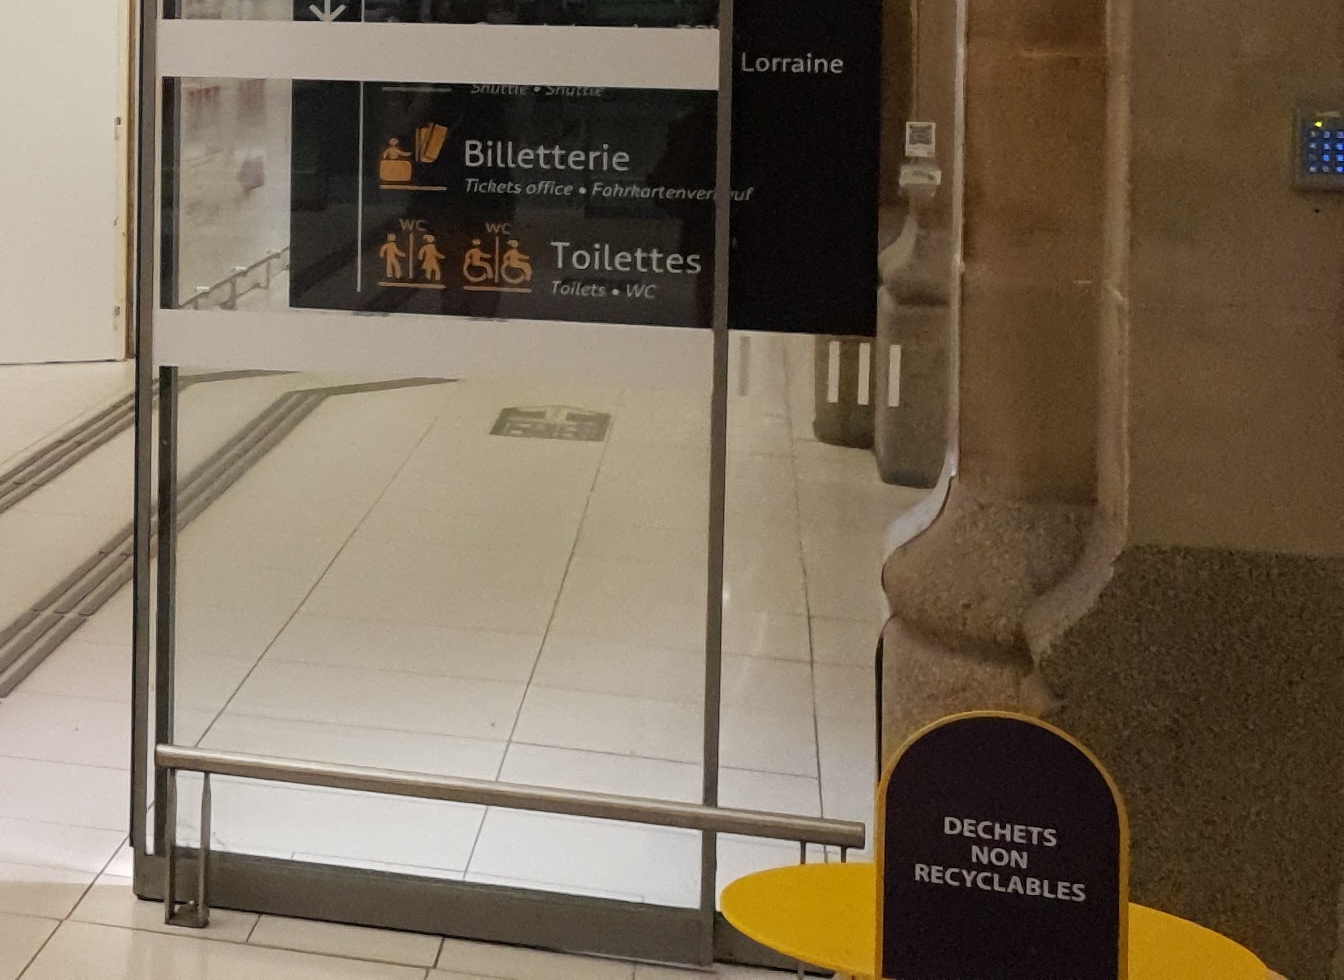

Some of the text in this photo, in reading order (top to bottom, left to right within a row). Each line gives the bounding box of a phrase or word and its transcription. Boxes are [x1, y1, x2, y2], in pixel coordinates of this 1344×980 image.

[741, 52, 844, 75] Lorraine
[465, 139, 630, 171] Billetterie
[465, 178, 522, 195] Tickets
[525, 180, 574, 196] office
[399, 219, 425, 231] WC
[485, 222, 511, 235] WC
[550, 241, 702, 274] Toilettes
[551, 280, 657, 299] Toilets WC
[944, 816, 1057, 847] DECHETS
[971, 845, 1028, 869] NON
[914, 863, 1087, 902] RECYCLABLES
